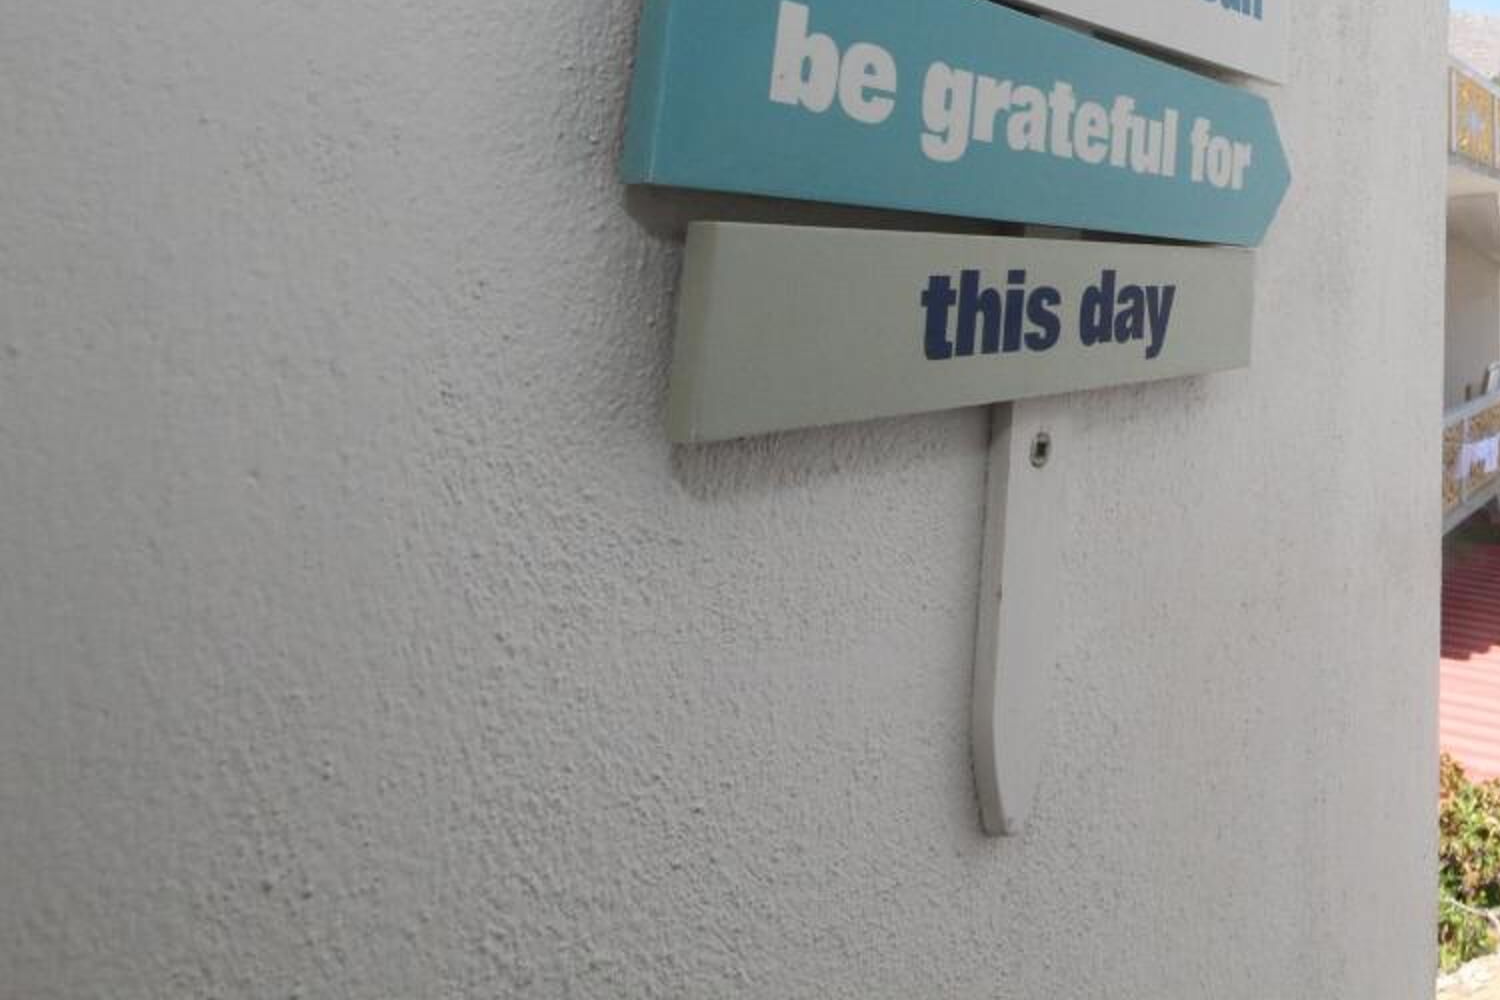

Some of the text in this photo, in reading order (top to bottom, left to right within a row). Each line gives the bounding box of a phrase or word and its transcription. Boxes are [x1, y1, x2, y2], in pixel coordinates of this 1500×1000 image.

[920, 60, 1177, 176] grateful
[1190, 118, 1252, 190] for
[920, 268, 1176, 360] this day
